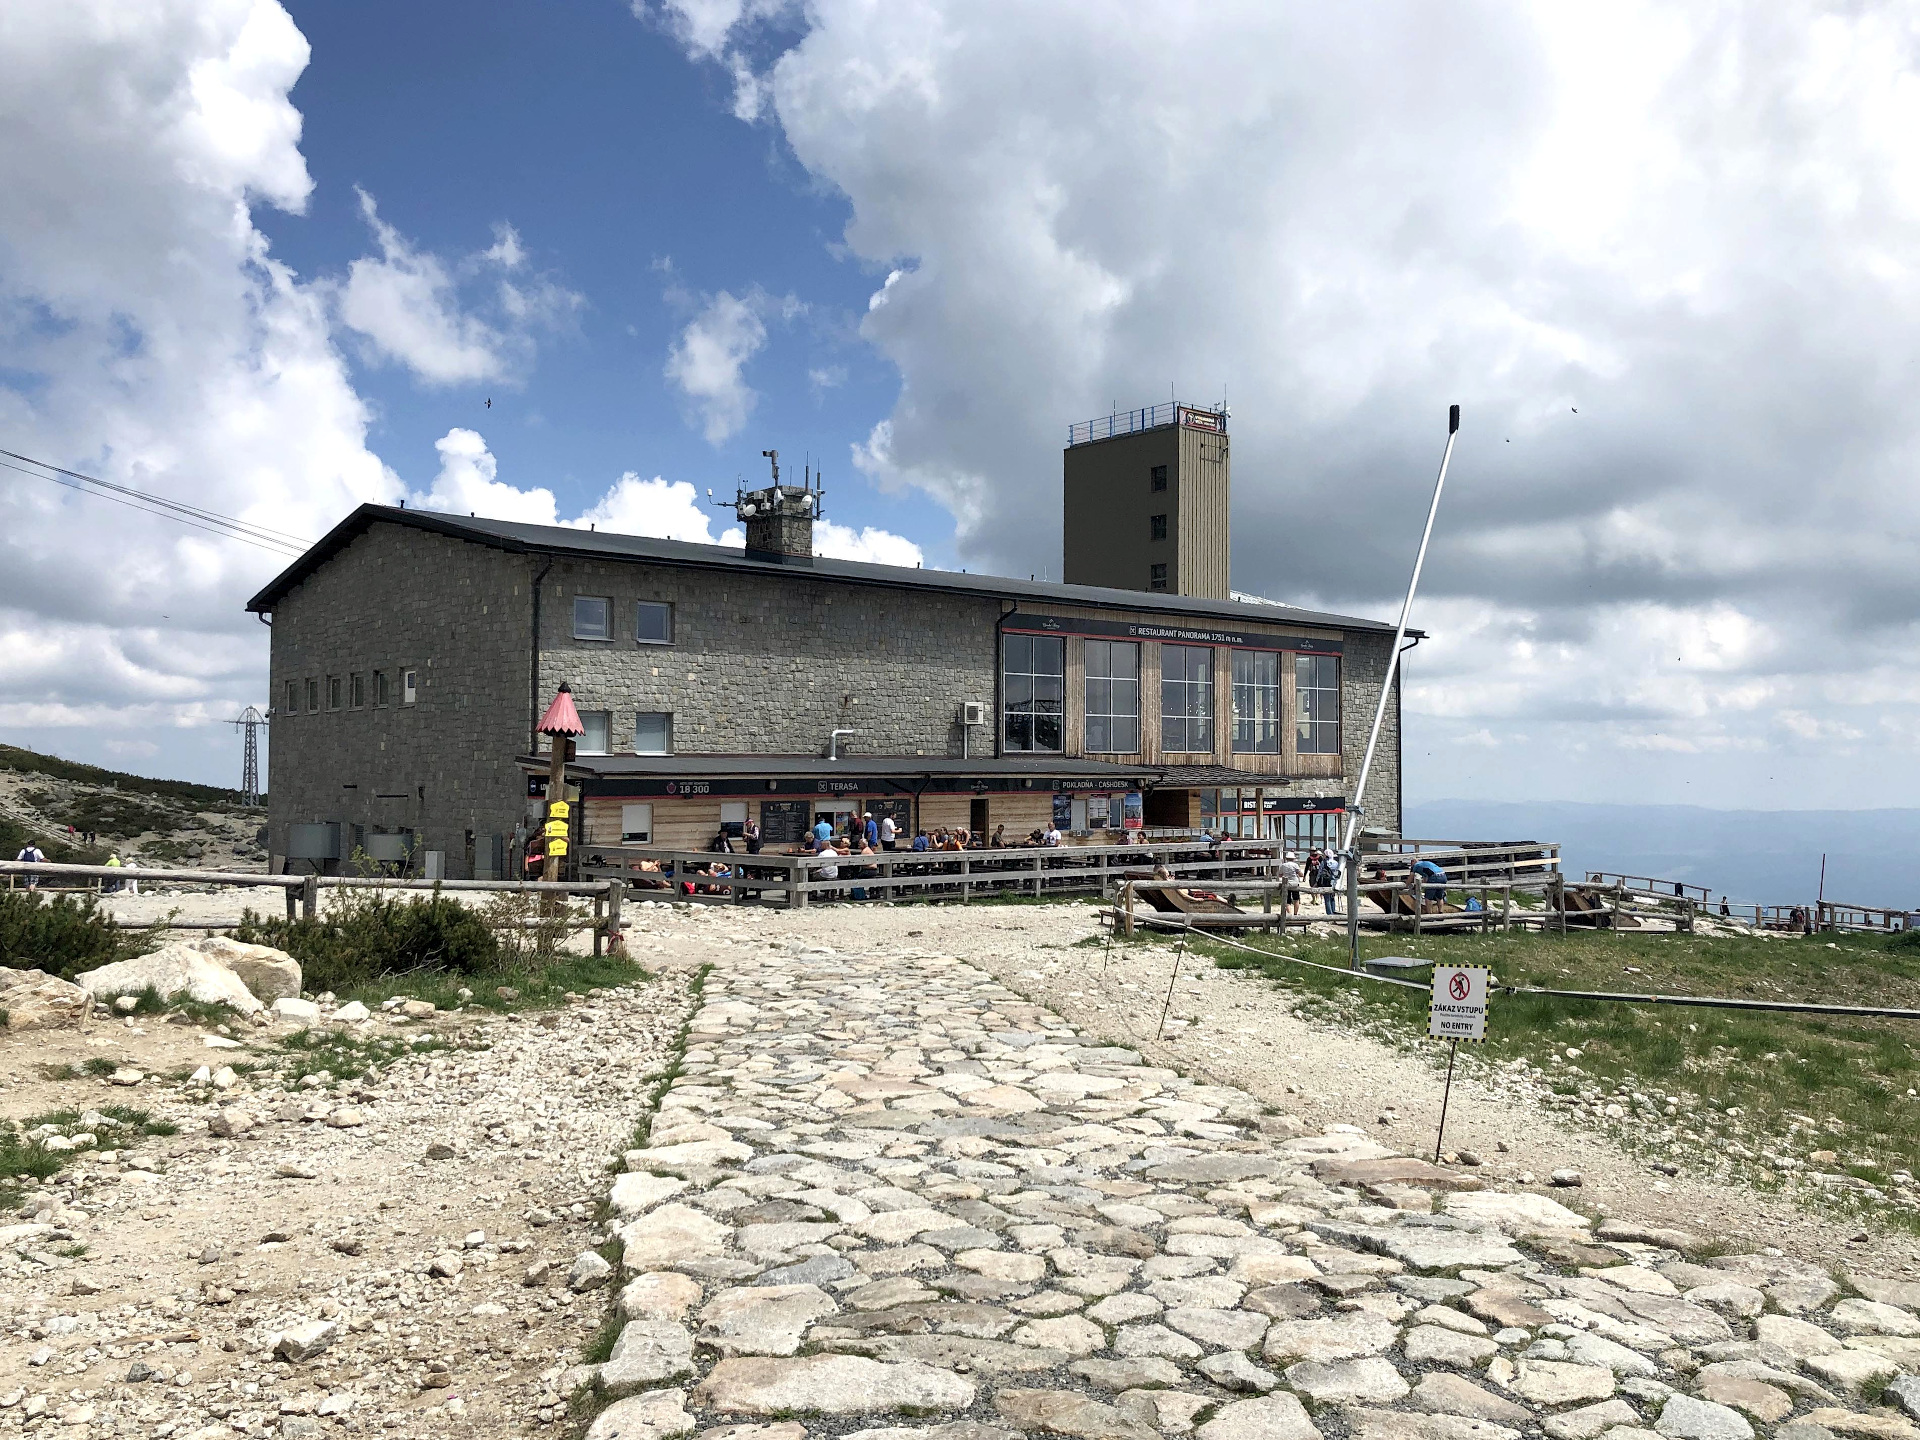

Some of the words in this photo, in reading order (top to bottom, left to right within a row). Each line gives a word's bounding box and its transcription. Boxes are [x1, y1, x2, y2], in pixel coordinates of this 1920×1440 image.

[1138, 627, 1177, 638] RESTAURANT
[1178, 630, 1210, 641] PANORAMA
[1211, 633, 1225, 642] 1751
[679, 785, 690, 794] 18
[692, 785, 710, 794] 300
[830, 782, 859, 791] TERASA
[1434, 1003, 1456, 1013] ZÁKAZ
[1457, 1005, 1484, 1014] VSTUPU
[1441, 1021, 1451, 1029] NO
[1452, 1022, 1473, 1030] ENTRY
